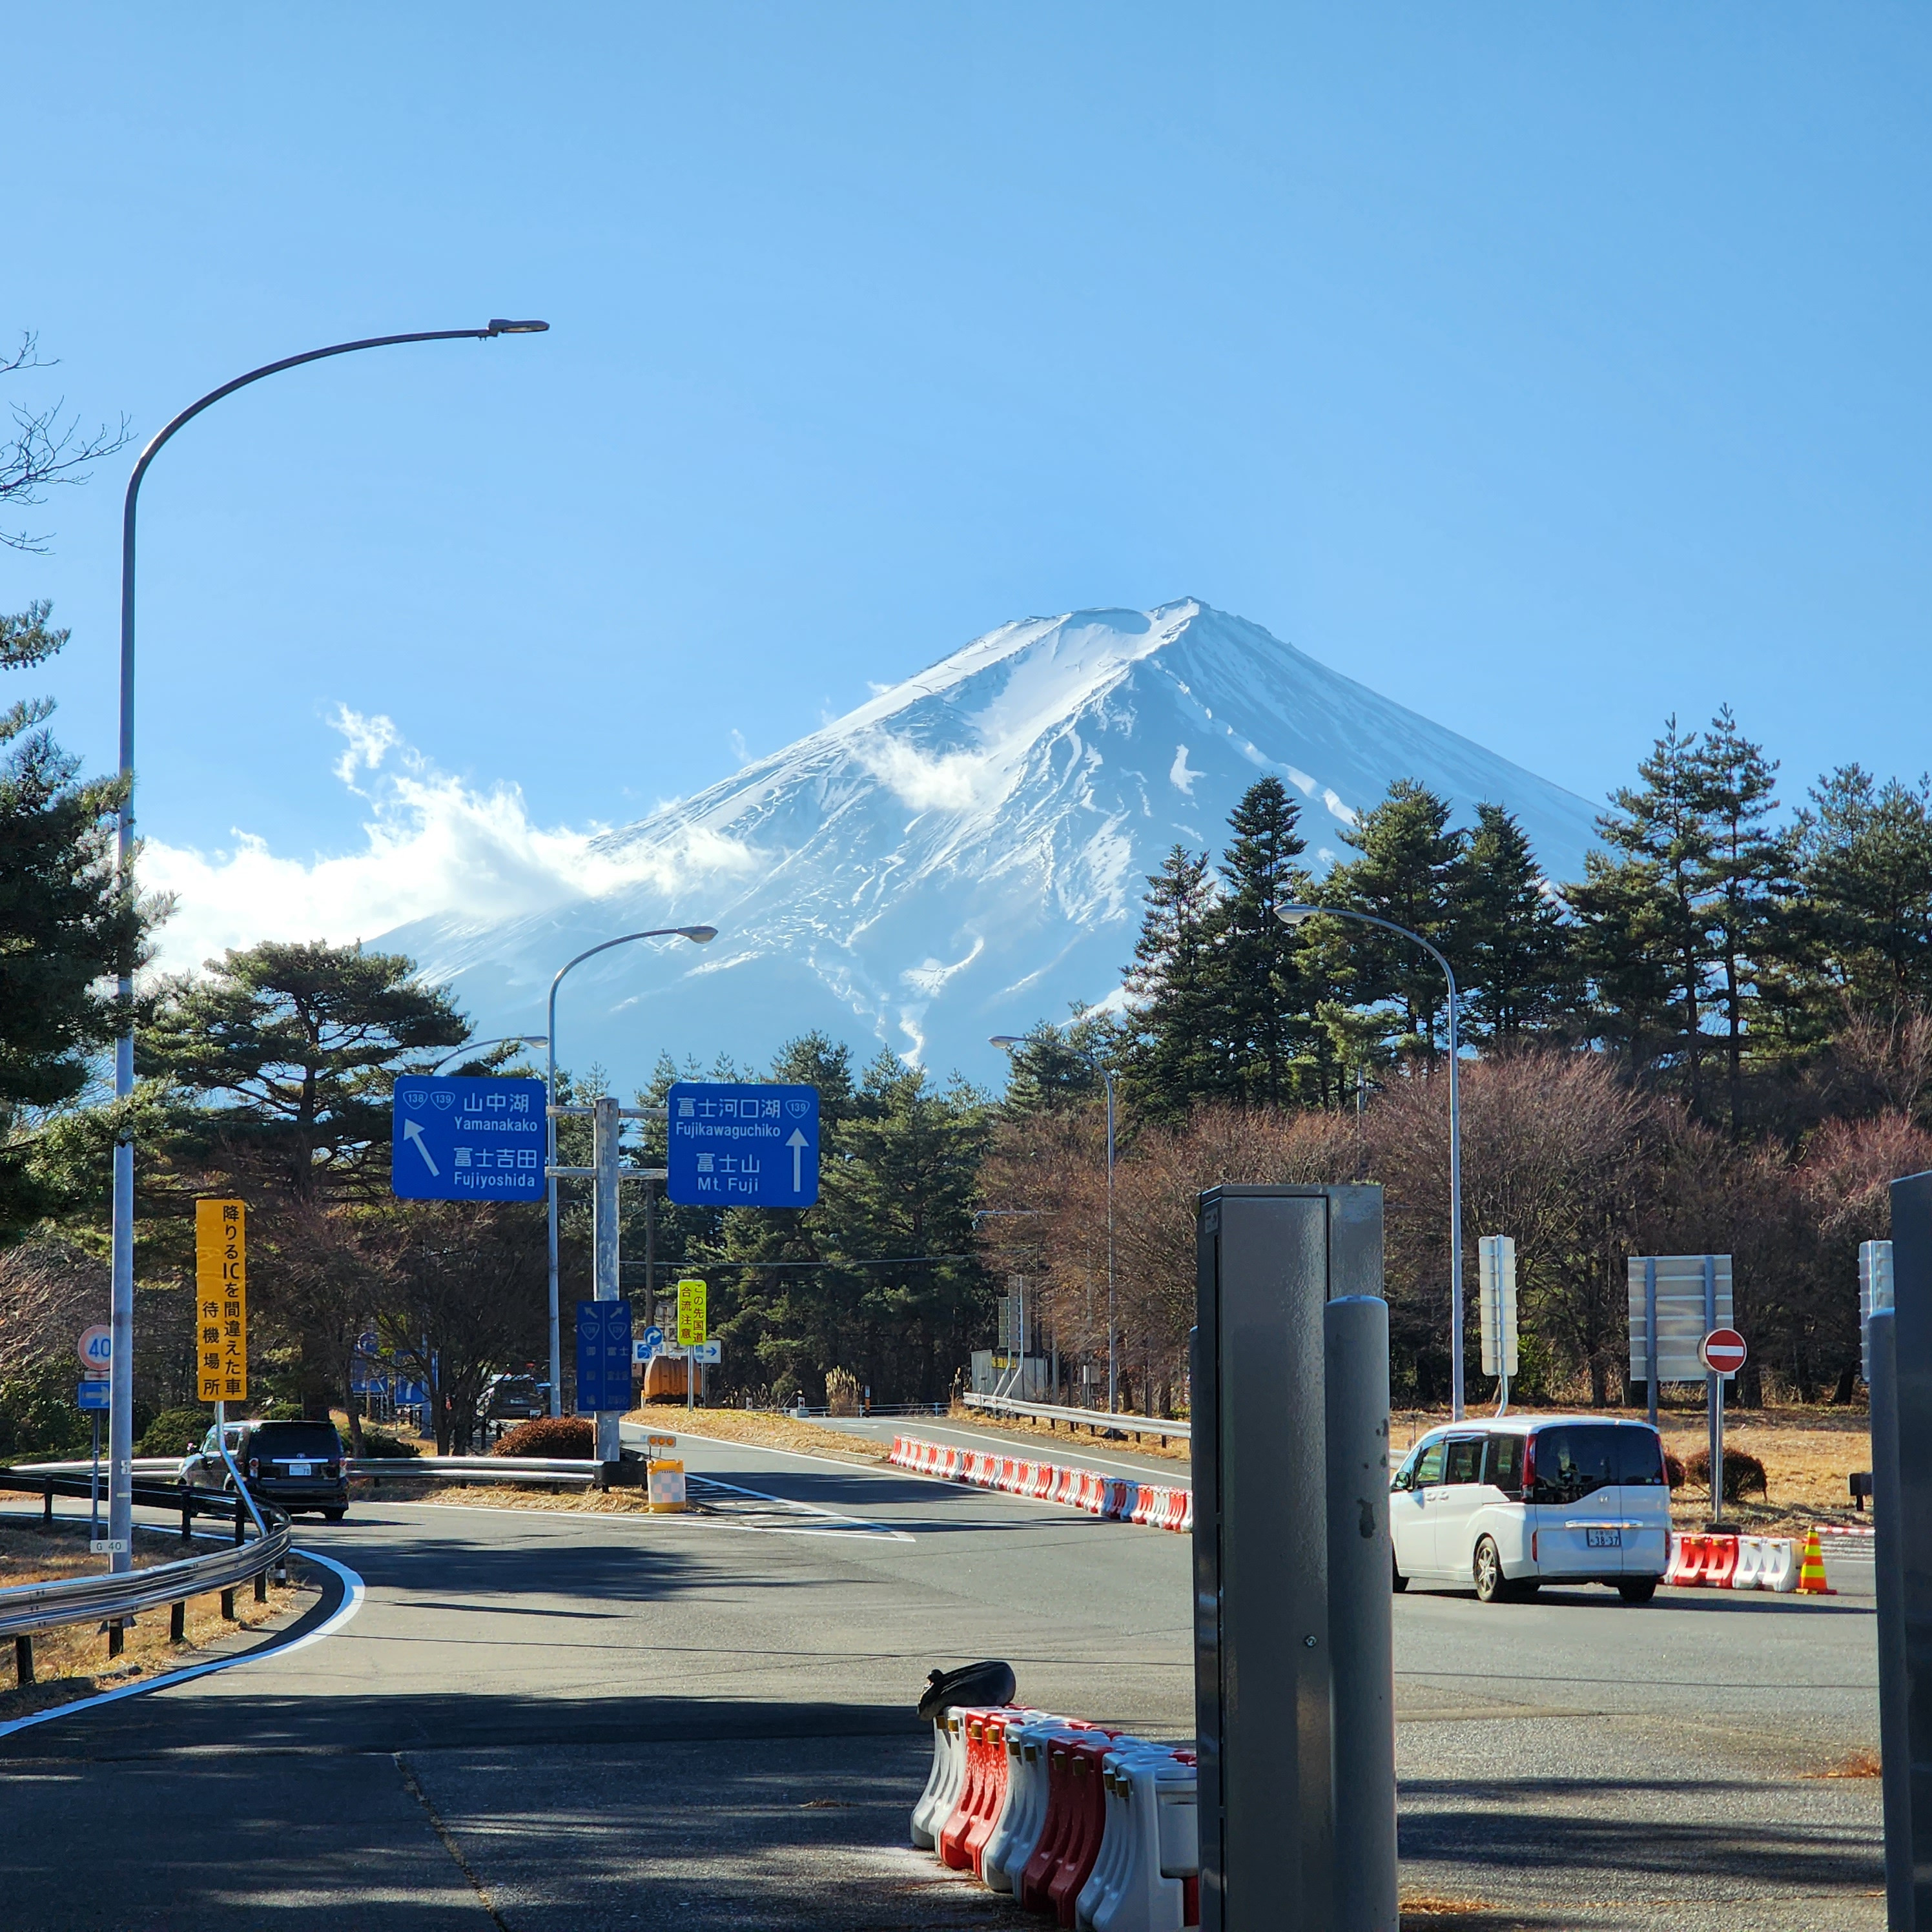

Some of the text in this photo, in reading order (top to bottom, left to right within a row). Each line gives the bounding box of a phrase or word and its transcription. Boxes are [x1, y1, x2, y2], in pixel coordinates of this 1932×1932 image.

[408, 1093, 451, 1104] 138 139
[464, 1093, 529, 1113] 山中湖
[677, 1097, 781, 1118] 富士河口湖
[791, 1103, 806, 1112] 139
[454, 1116, 538, 1132] Yamanakako
[675, 1121, 781, 1140] Fujikawaguchiko
[453, 1147, 537, 1169] 富士吉田
[696, 1153, 760, 1173] 富士山
[454, 1171, 535, 1189] Fujiyoshida
[697, 1177, 758, 1194] Mt. Fuji
[222, 1205, 242, 1395] 降りるICを間違えた車
[681, 1286, 692, 1339] 合流注意
[693, 1284, 704, 1344] この先国道
[88, 1338, 110, 1358] 40
[202, 1300, 220, 1396] 待機場所
[96, 1542, 121, 1551] G 40
